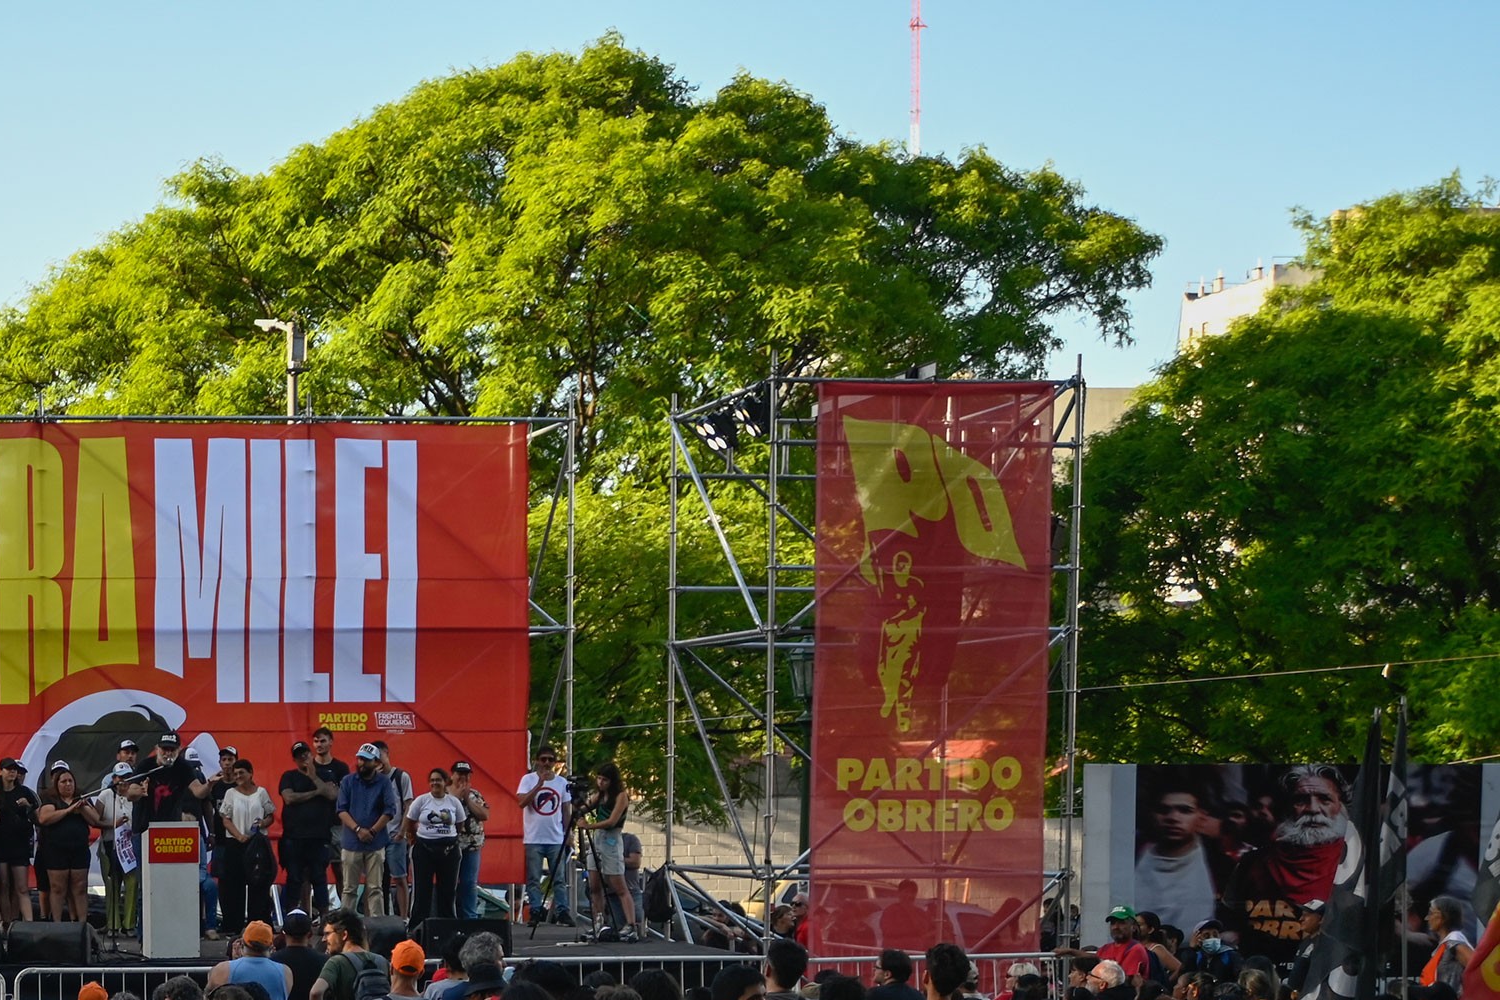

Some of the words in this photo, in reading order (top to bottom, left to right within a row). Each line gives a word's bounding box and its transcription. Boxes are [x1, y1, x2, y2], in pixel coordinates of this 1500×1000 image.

[153, 437, 418, 705] MILEI
[319, 712, 368, 723] PARTIDO
[836, 756, 1022, 792] PARTIDO
[843, 796, 1015, 832] OBRERO
[153, 837, 194, 846] PARTIDO
[155, 845, 192, 853] OBRERO
